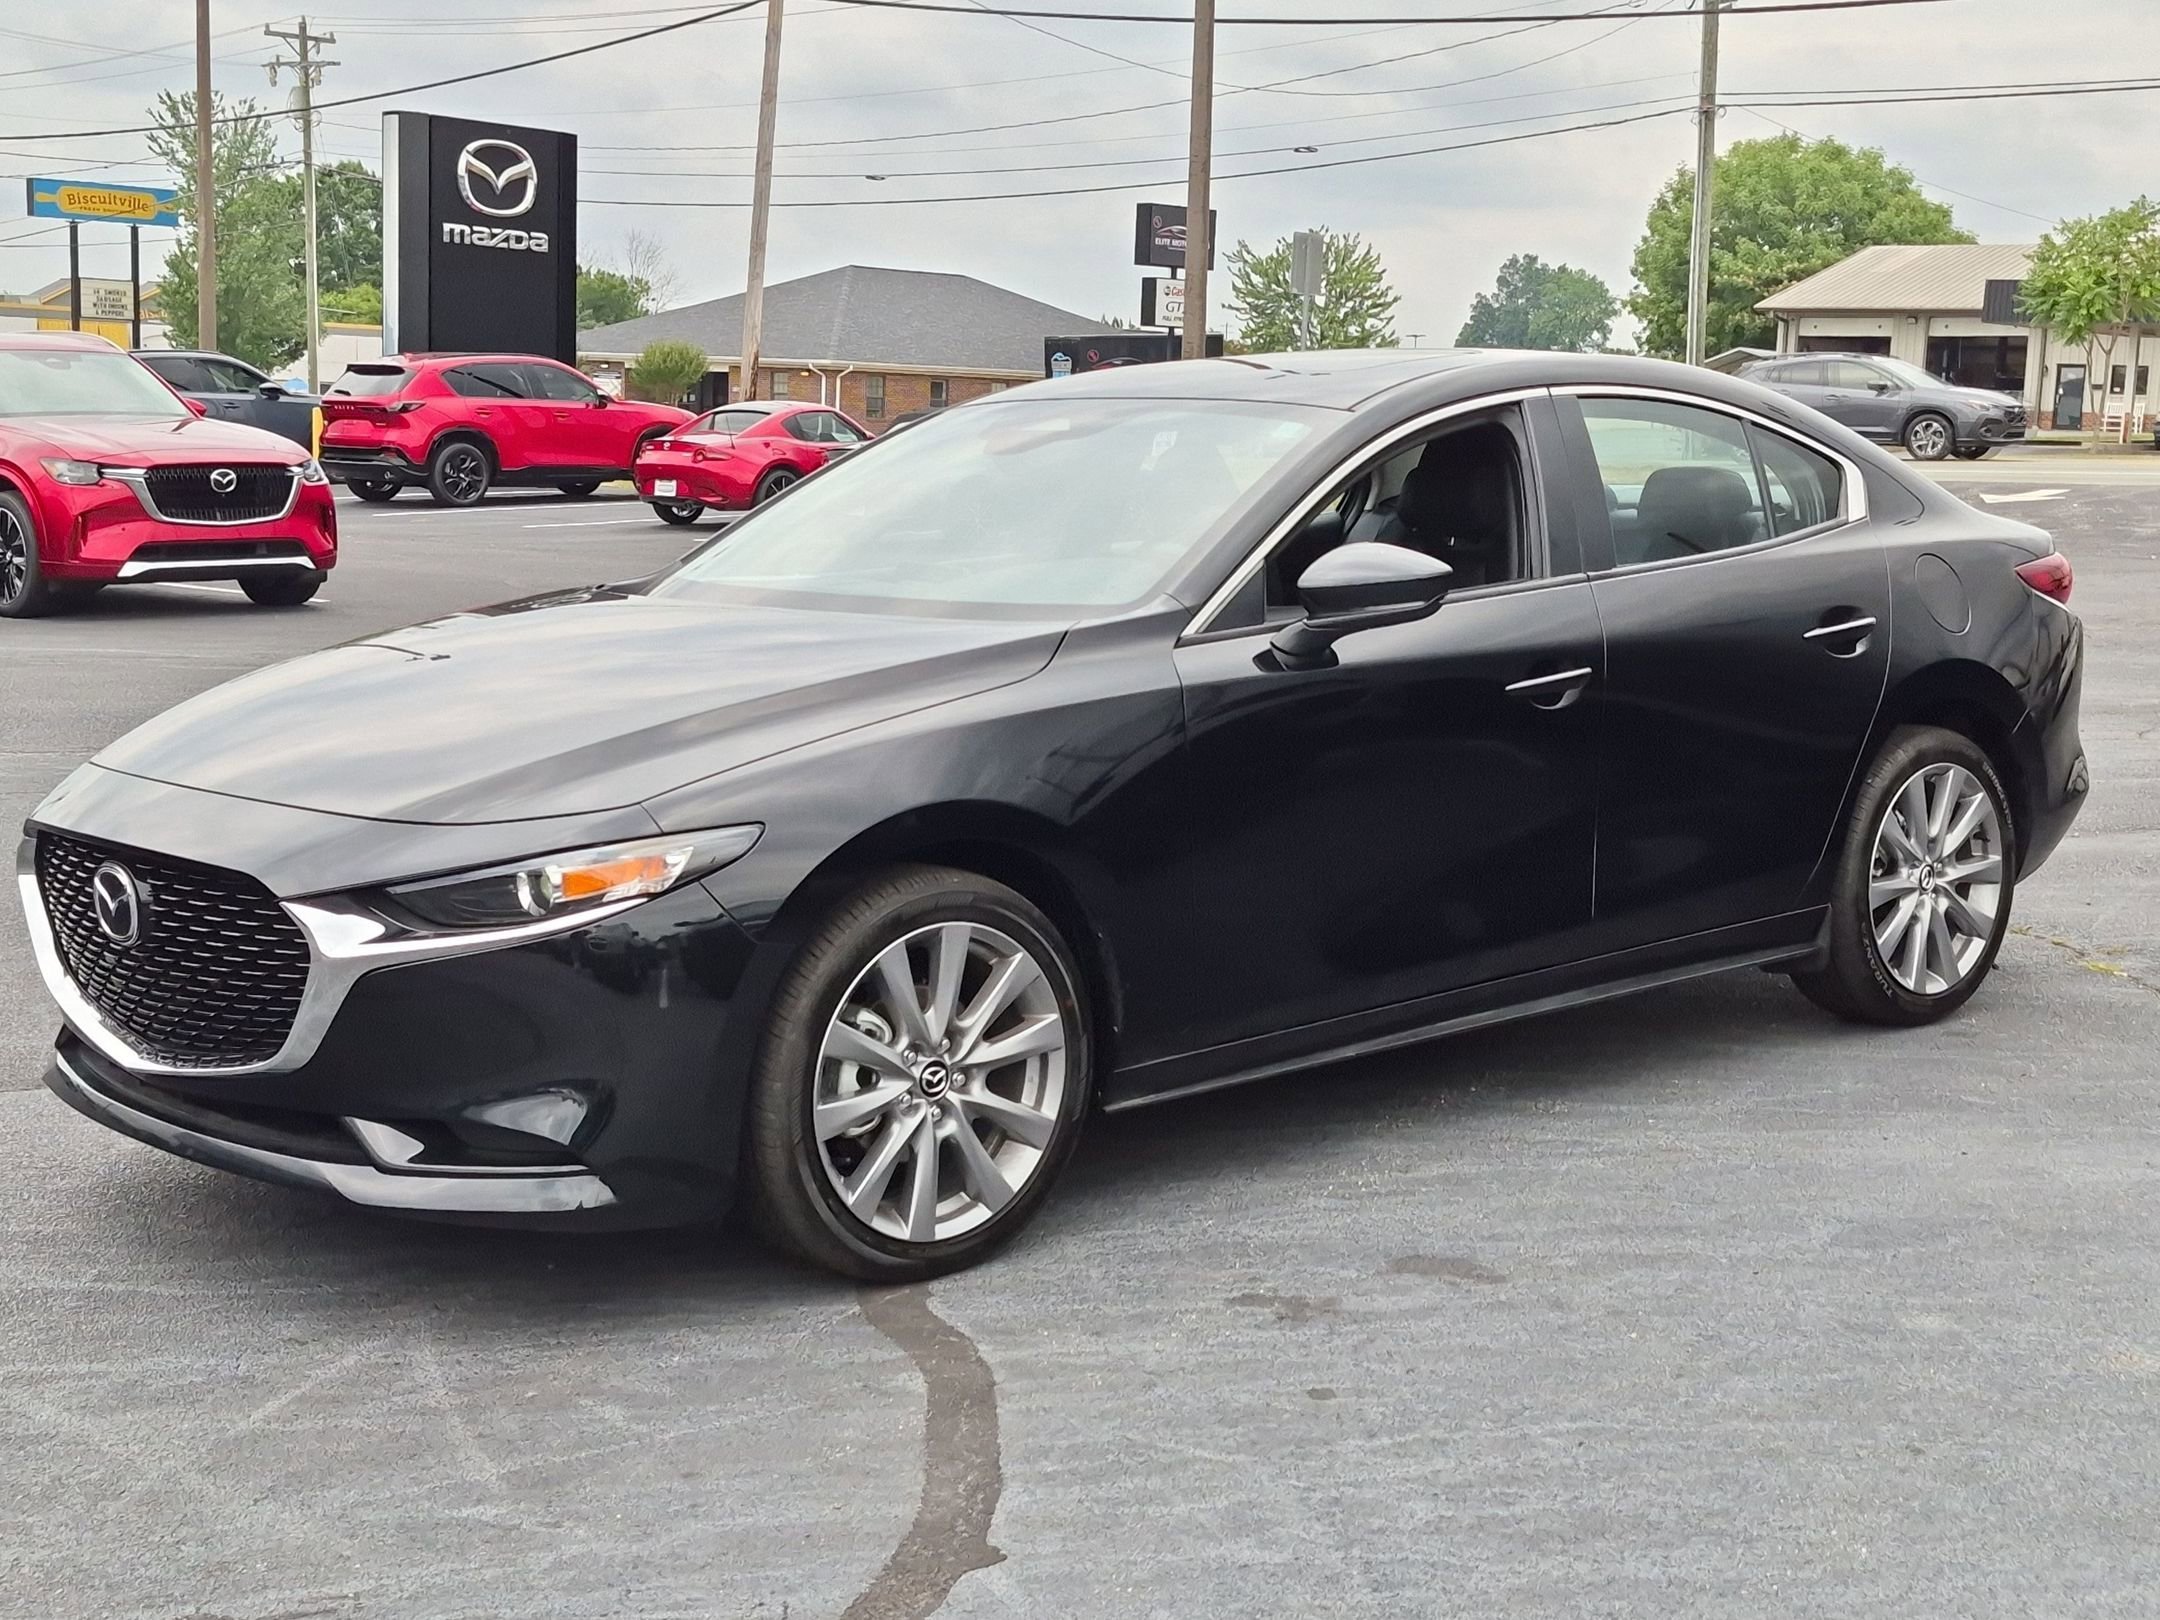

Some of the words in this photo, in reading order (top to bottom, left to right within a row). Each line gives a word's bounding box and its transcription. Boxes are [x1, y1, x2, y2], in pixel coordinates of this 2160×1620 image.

[66, 192, 149, 212] Biscuitville
[443, 222, 549, 253] mazda
[1171, 286, 1185, 296] Cas
[1166, 301, 1185, 313] GT
